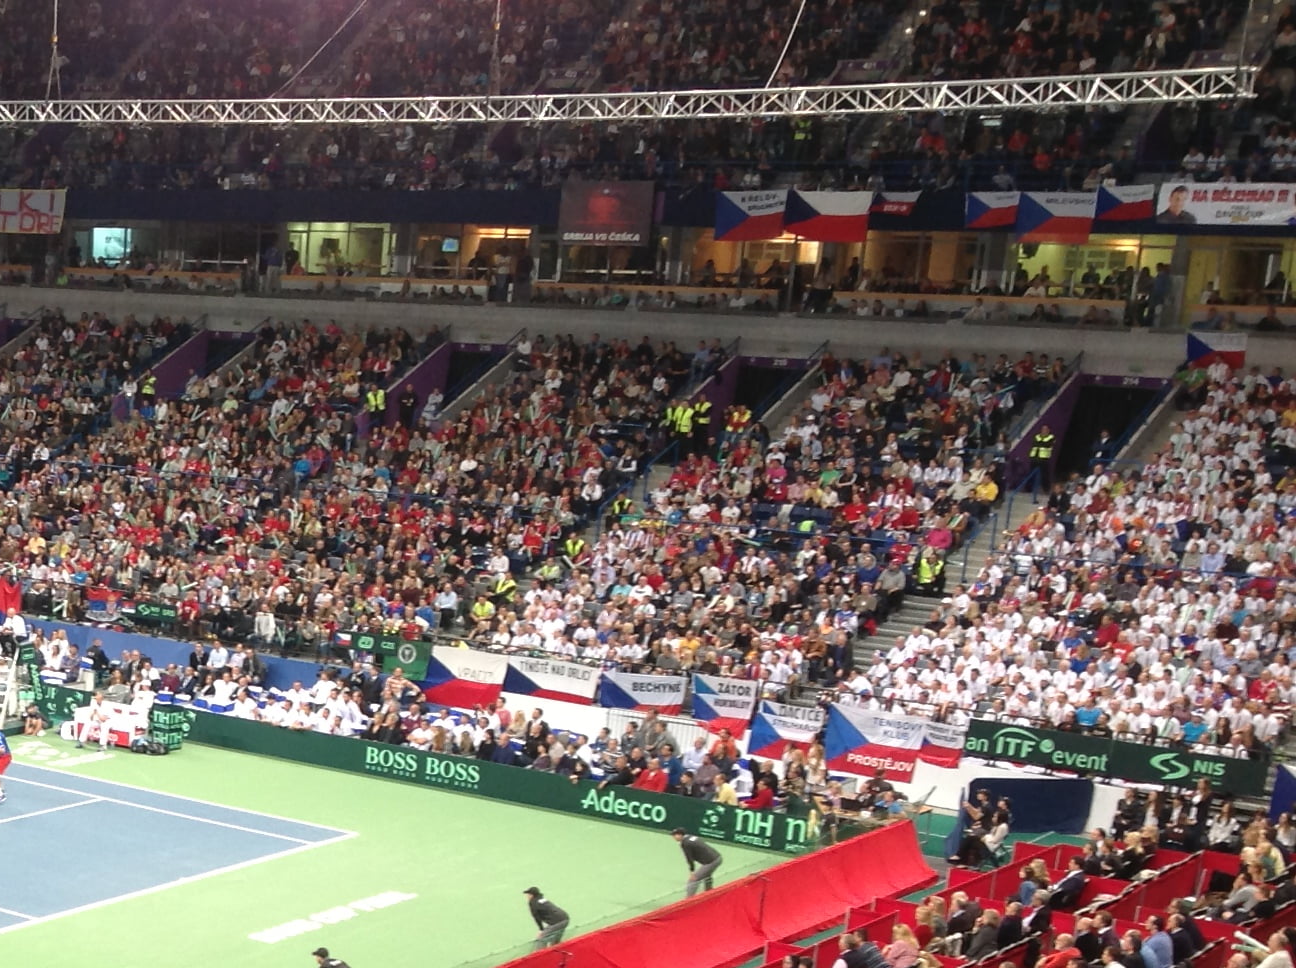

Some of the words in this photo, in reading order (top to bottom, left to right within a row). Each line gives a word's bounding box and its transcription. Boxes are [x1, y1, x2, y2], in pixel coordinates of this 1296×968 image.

[366, 746, 418, 772] BOSS
[425, 757, 480, 783] BOSS
[965, 737, 989, 752] an
[996, 736, 1036, 759] ITF
[1052, 750, 1109, 772] event
[1193, 759, 1226, 776] NIS
[581, 789, 667, 823] Adecco
[734, 832, 771, 848] HOTELS
